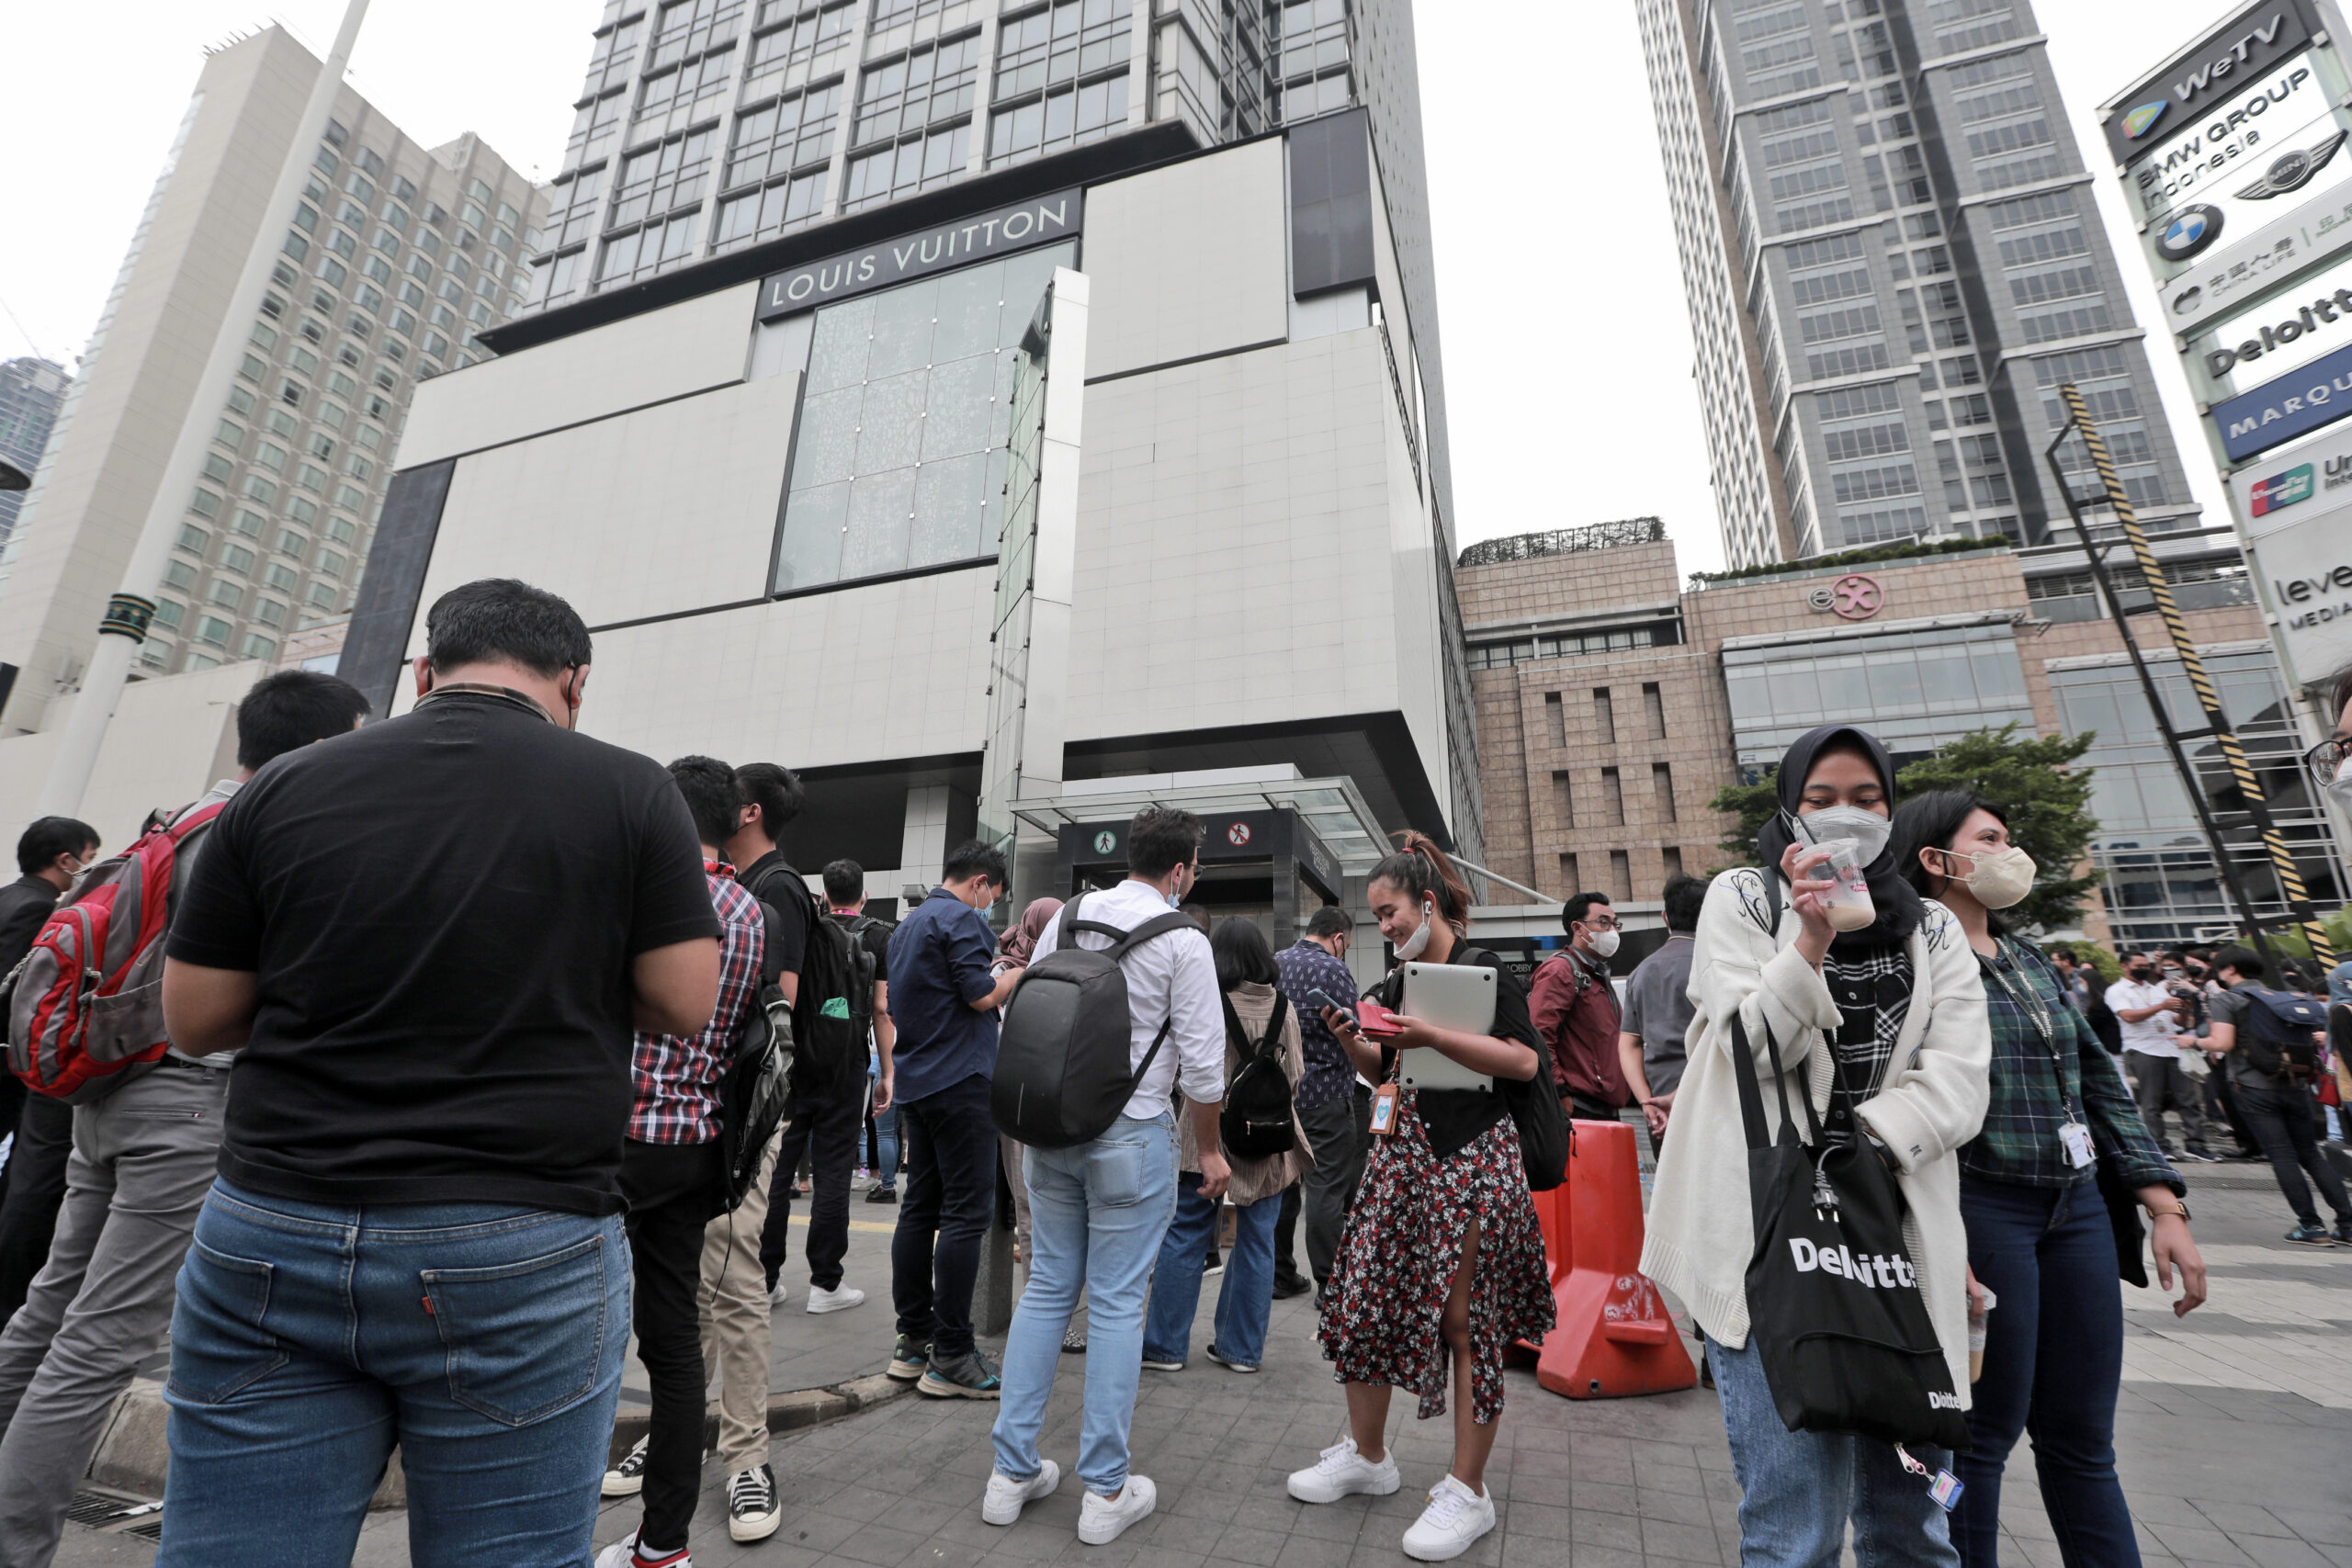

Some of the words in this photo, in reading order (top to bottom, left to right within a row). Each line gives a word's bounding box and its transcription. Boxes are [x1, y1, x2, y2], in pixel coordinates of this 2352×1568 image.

[2174, 14, 2283, 101] WeTV
[2136, 135, 2200, 190] BMW
[2207, 68, 2309, 142] GROUP
[2269, 154, 2306, 183] MINI
[772, 254, 876, 307] LOUIS
[893, 199, 1067, 272] VUITTON
[1507, 963, 1532, 973] OBBY
